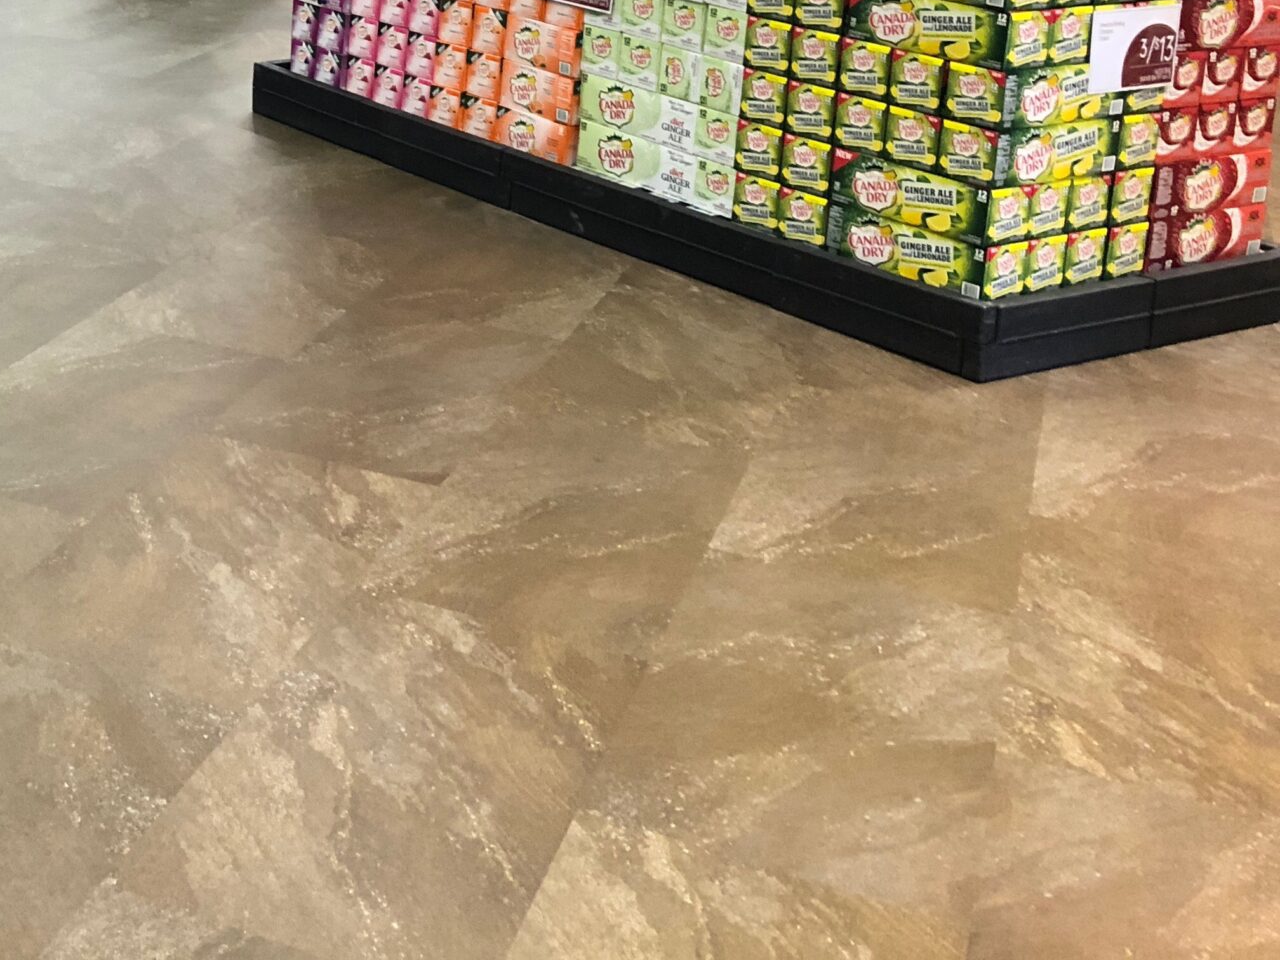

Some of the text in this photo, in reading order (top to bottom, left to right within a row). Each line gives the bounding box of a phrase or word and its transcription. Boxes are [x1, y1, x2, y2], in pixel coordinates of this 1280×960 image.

[870, 13, 917, 30] CANADA
[922, 16, 972, 24] GINGER ALE
[883, 25, 906, 36] DRY
[1209, 25, 1228, 40] DRY
[1140, 35, 1174, 64] 3/$13
[600, 100, 635, 110] CANADA
[1033, 102, 1050, 116] DRY
[610, 110, 626, 120] DRY
[670, 118, 683, 127] diet
[661, 123, 691, 138] GINGER
[668, 134, 682, 143] ALE
[599, 148, 634, 159] CANADA
[609, 159, 626, 169] DRY
[670, 167, 683, 177] diet
[660, 173, 690, 188] GINGER
[668, 185, 682, 194] ALE
[853, 179, 899, 195] CANADA
[905, 186, 953, 198] GINGER ALE
[866, 191, 889, 203] DRY
[916, 195, 953, 206] LEMONADE
[1196, 188, 1212, 205] DRY
[848, 234, 896, 251] CANADA
[900, 241, 950, 254] GINGER ALE
[862, 246, 885, 257] DRY
[1190, 243, 1206, 258] DRY
[913, 251, 950, 262] LEMONADE
